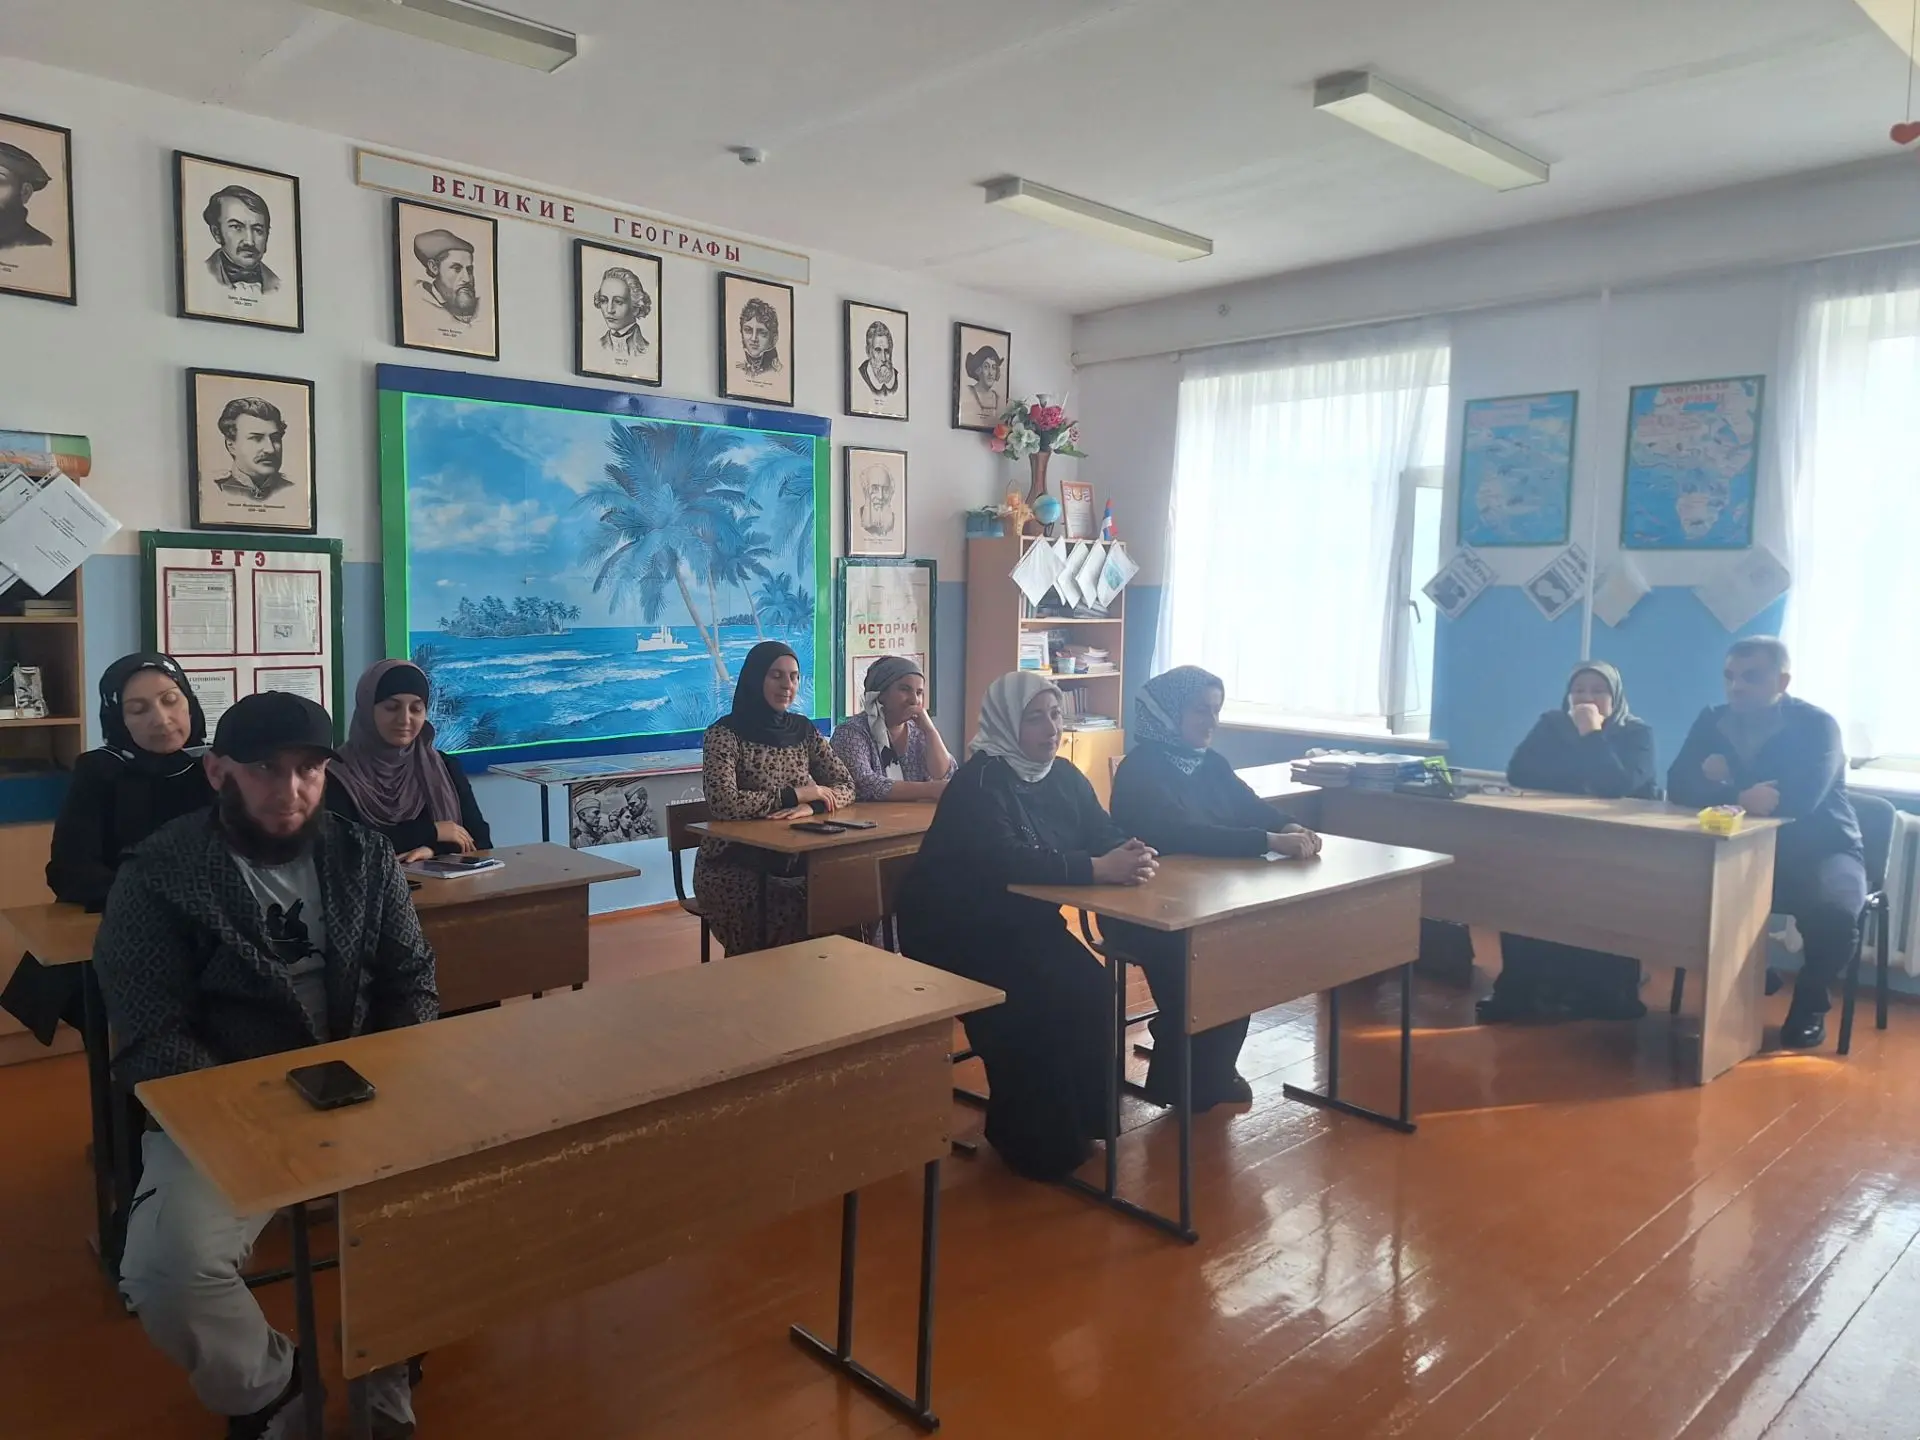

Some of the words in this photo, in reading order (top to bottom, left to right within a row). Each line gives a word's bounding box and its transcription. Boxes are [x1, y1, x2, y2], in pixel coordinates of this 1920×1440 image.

[432, 175, 575, 223] ВЕЛИКИЕ
[614, 217, 740, 262] ГЕОГРАФЫ
[211, 550, 266, 567] ЕГЭ
[858, 622, 918, 635] ИСТОРИЯ
[868, 637, 905, 649] СЕЛА
